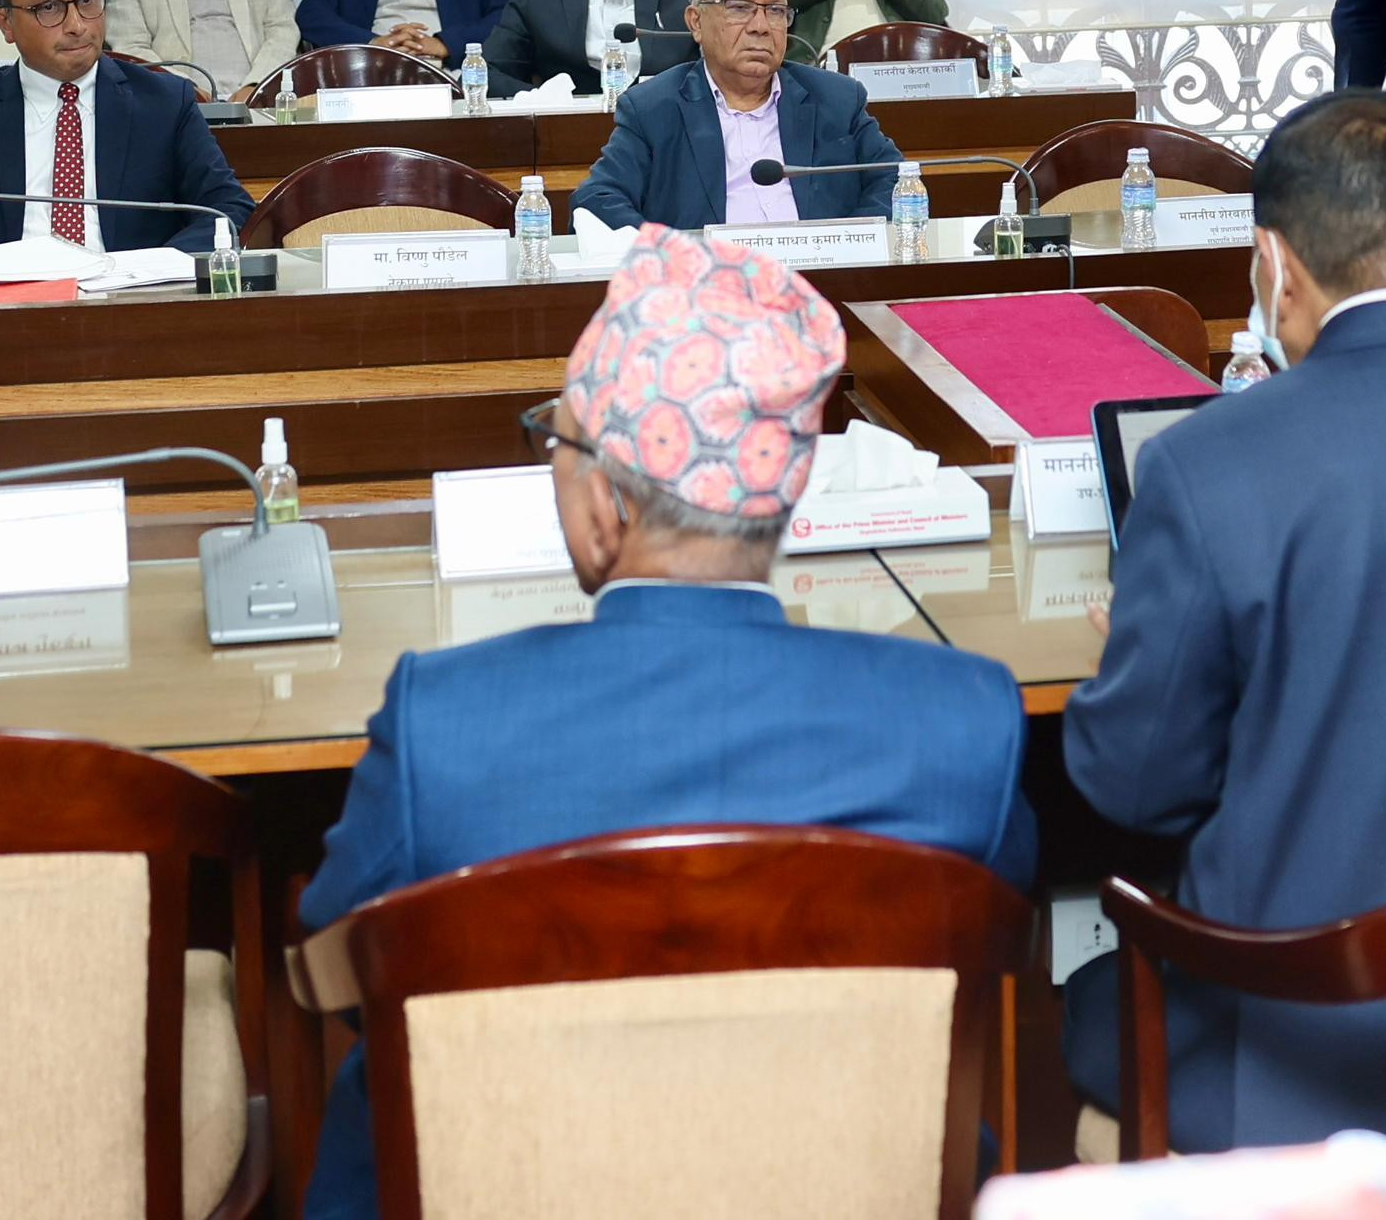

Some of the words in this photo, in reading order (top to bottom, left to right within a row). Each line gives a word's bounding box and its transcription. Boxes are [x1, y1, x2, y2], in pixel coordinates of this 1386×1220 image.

[874, 65, 905, 77] माननीय
[908, 64, 930, 76] केदार
[1179, 208, 1215, 221] माननीय
[777, 236, 808, 246] माधव
[812, 235, 842, 250] कुमार
[845, 231, 876, 243] नेपाल
[374, 253, 392, 263] मा.
[397, 248, 428, 267] विष्णु
